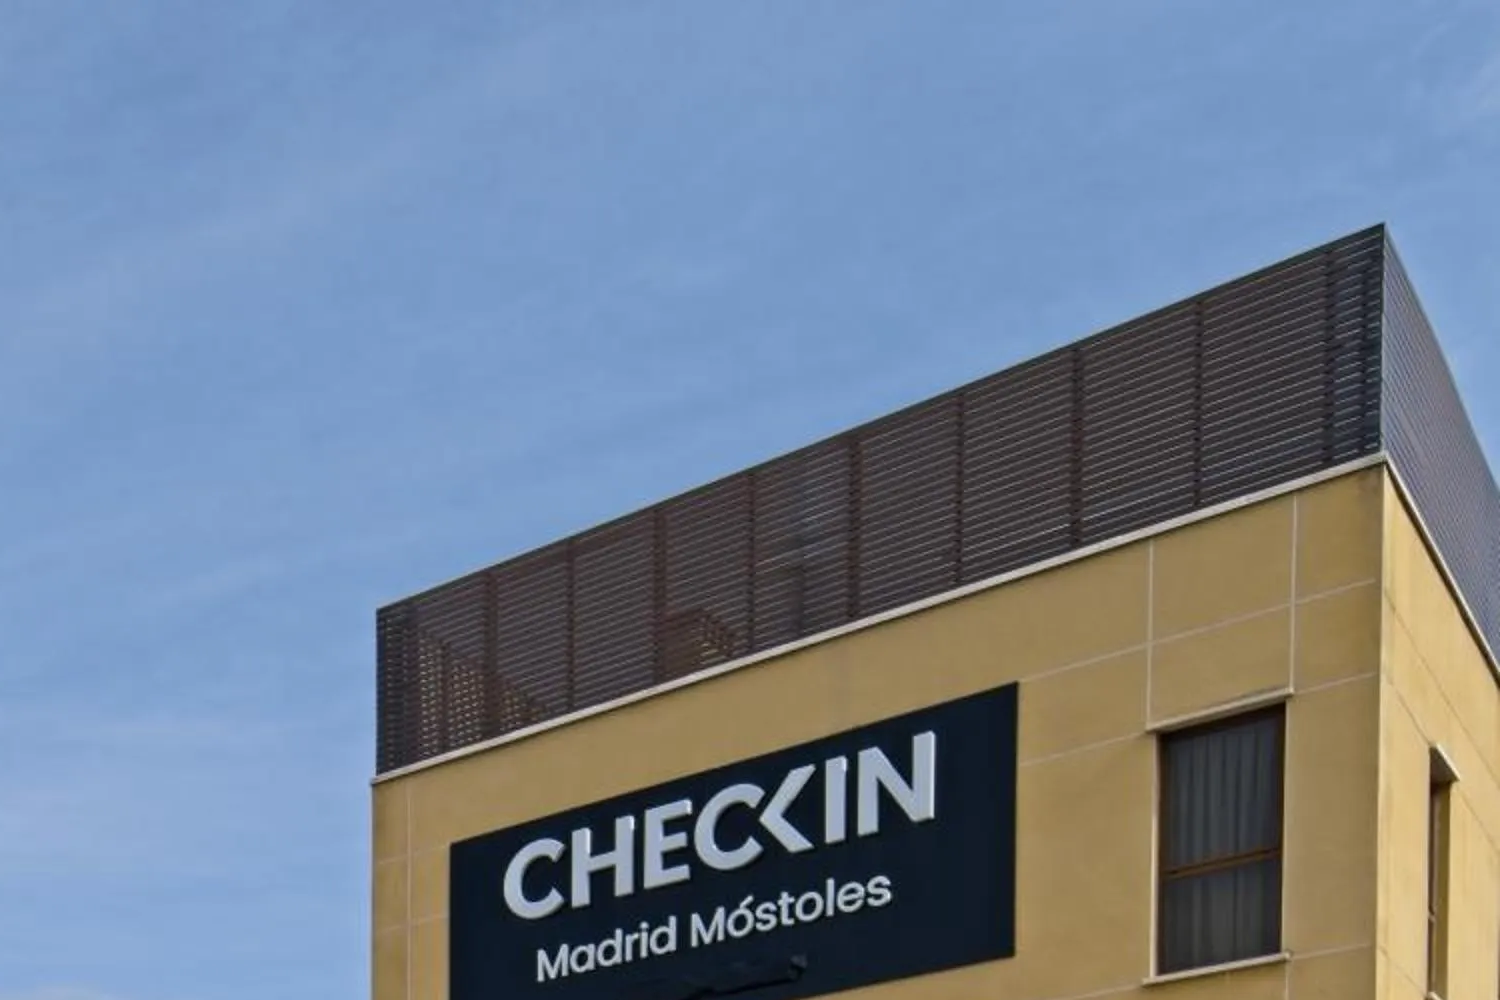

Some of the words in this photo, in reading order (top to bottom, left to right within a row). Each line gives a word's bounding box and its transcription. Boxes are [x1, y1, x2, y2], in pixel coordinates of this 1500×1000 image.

[503, 730, 936, 920] CHECKIN
[536, 916, 677, 982] Madrid
[690, 874, 892, 948] Móstoles
